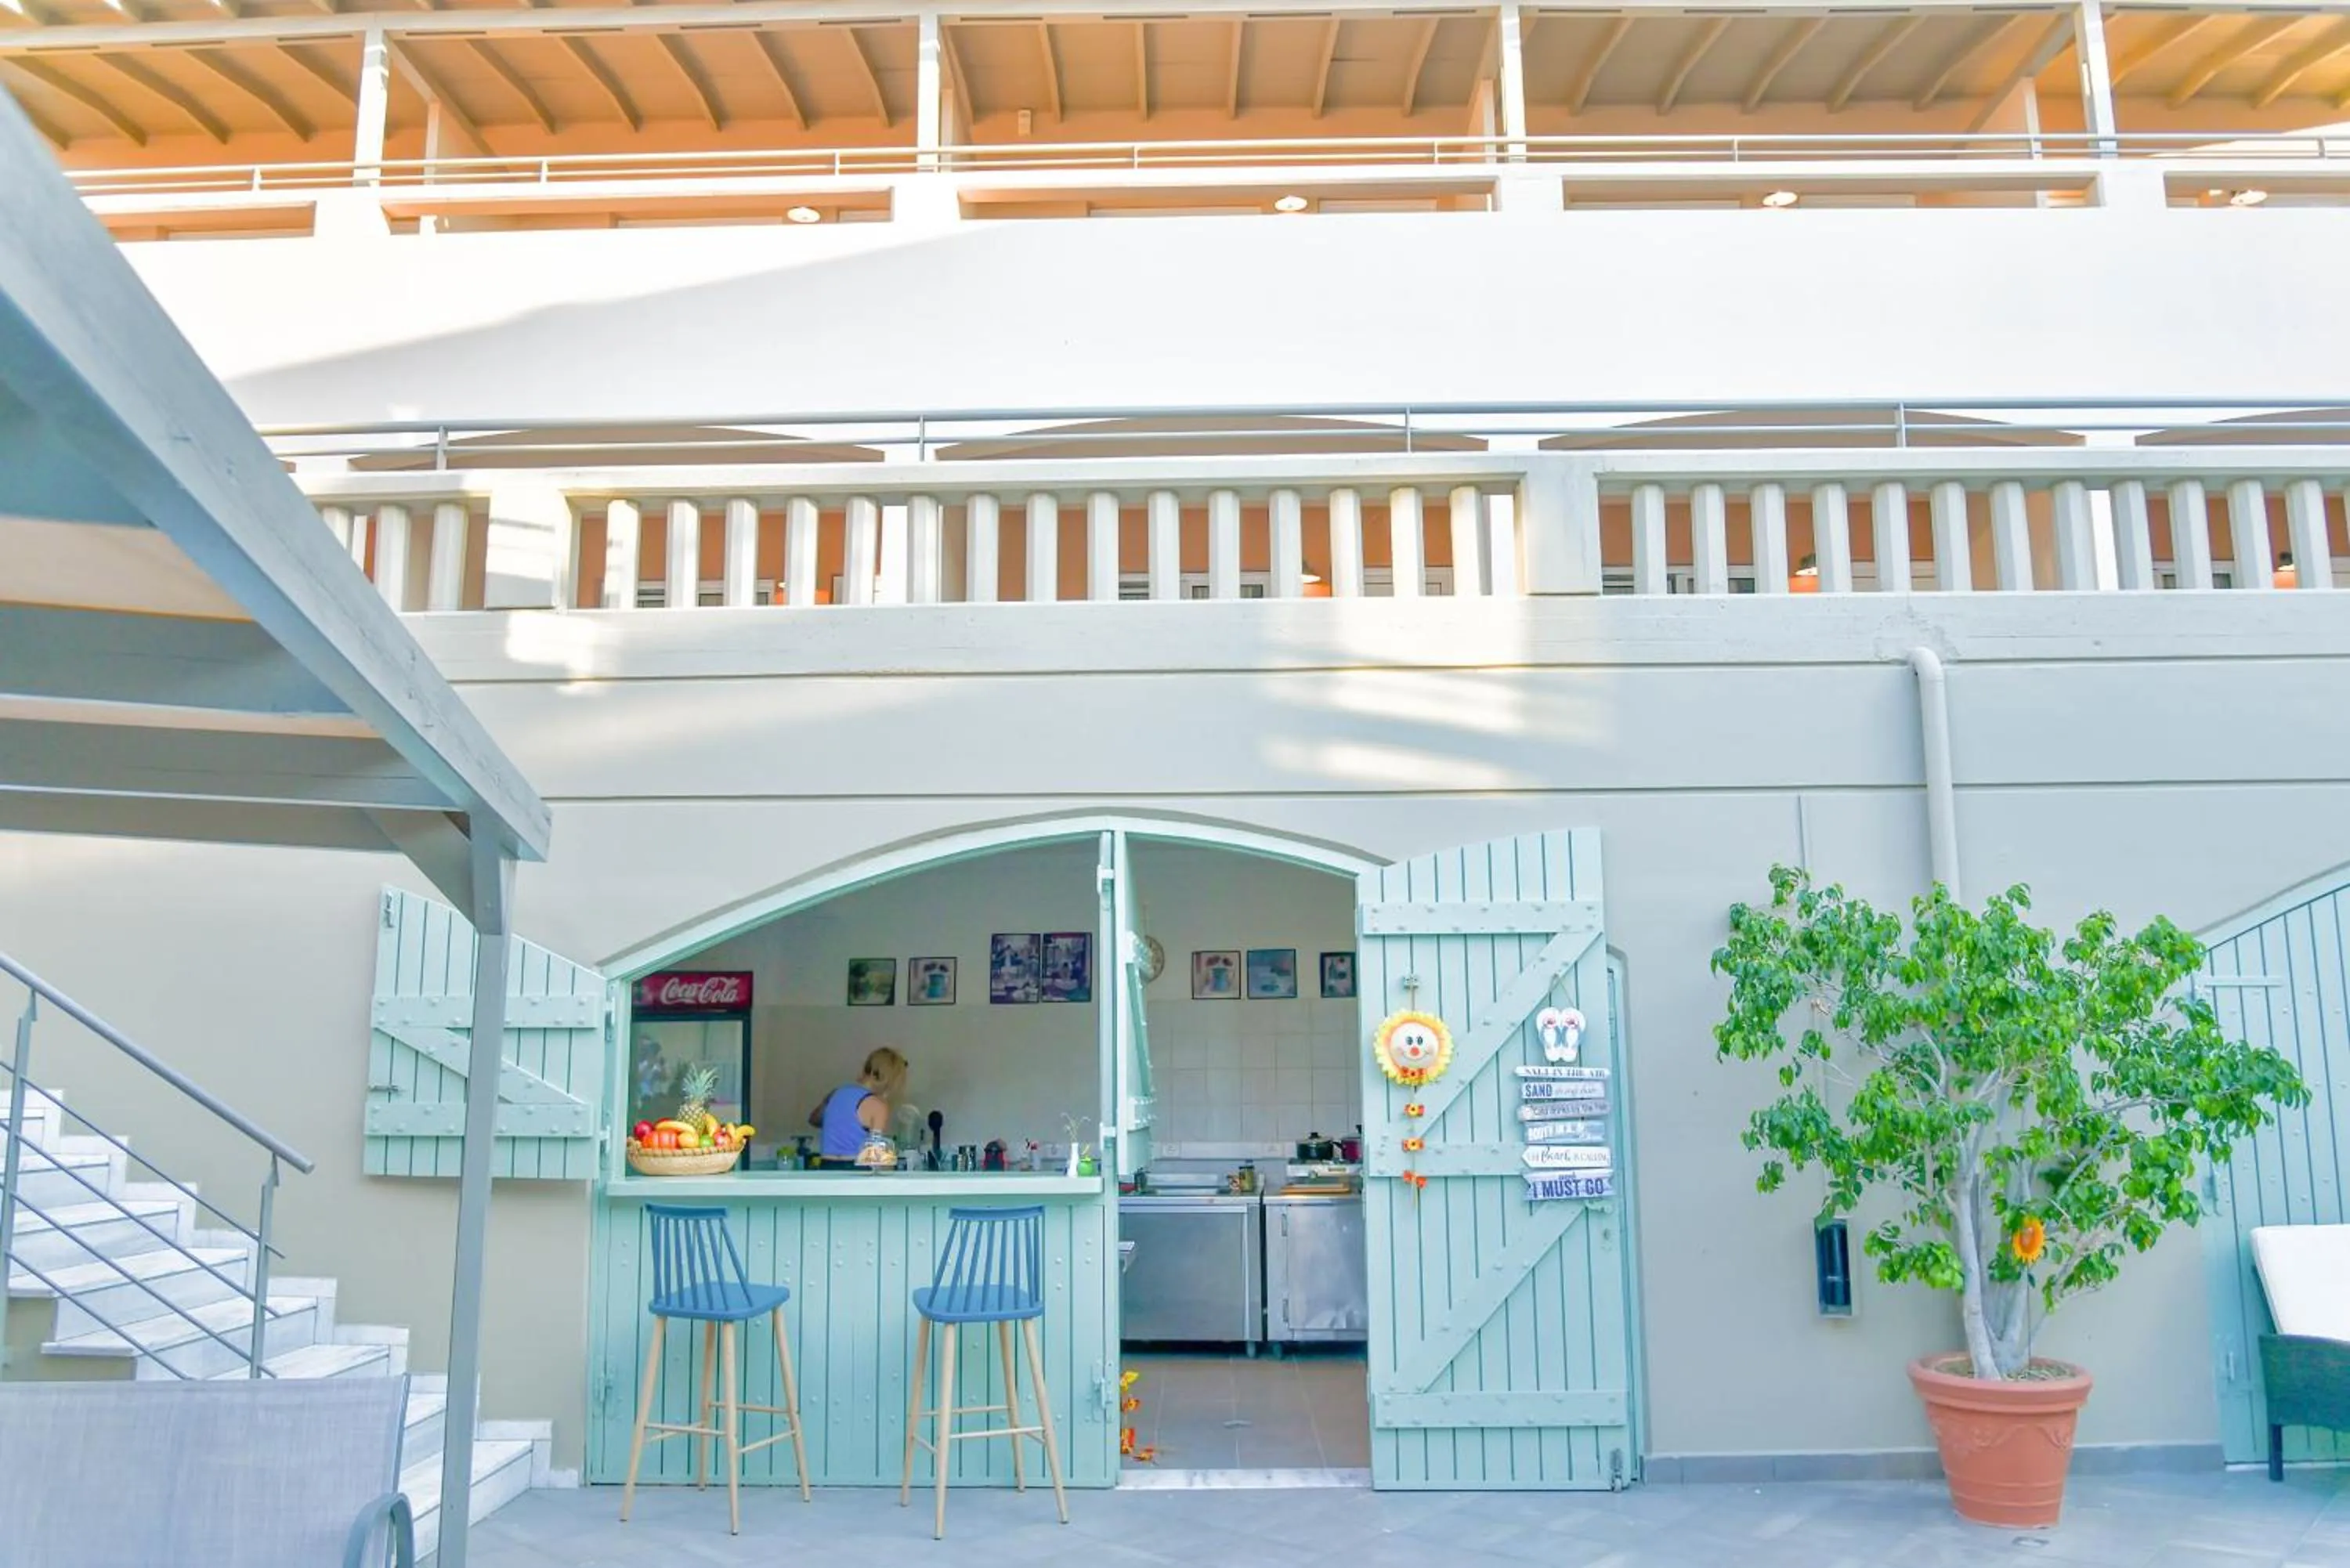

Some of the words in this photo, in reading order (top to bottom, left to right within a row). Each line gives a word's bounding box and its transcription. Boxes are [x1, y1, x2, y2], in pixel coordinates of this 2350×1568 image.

[660, 977, 740, 1005] Coca-Cola
[1525, 1083, 1553, 1097] SAND
[1533, 1182, 1538, 1198] I
[1542, 1179, 1581, 1198] MUST
[1585, 1178, 1604, 1196] GO
